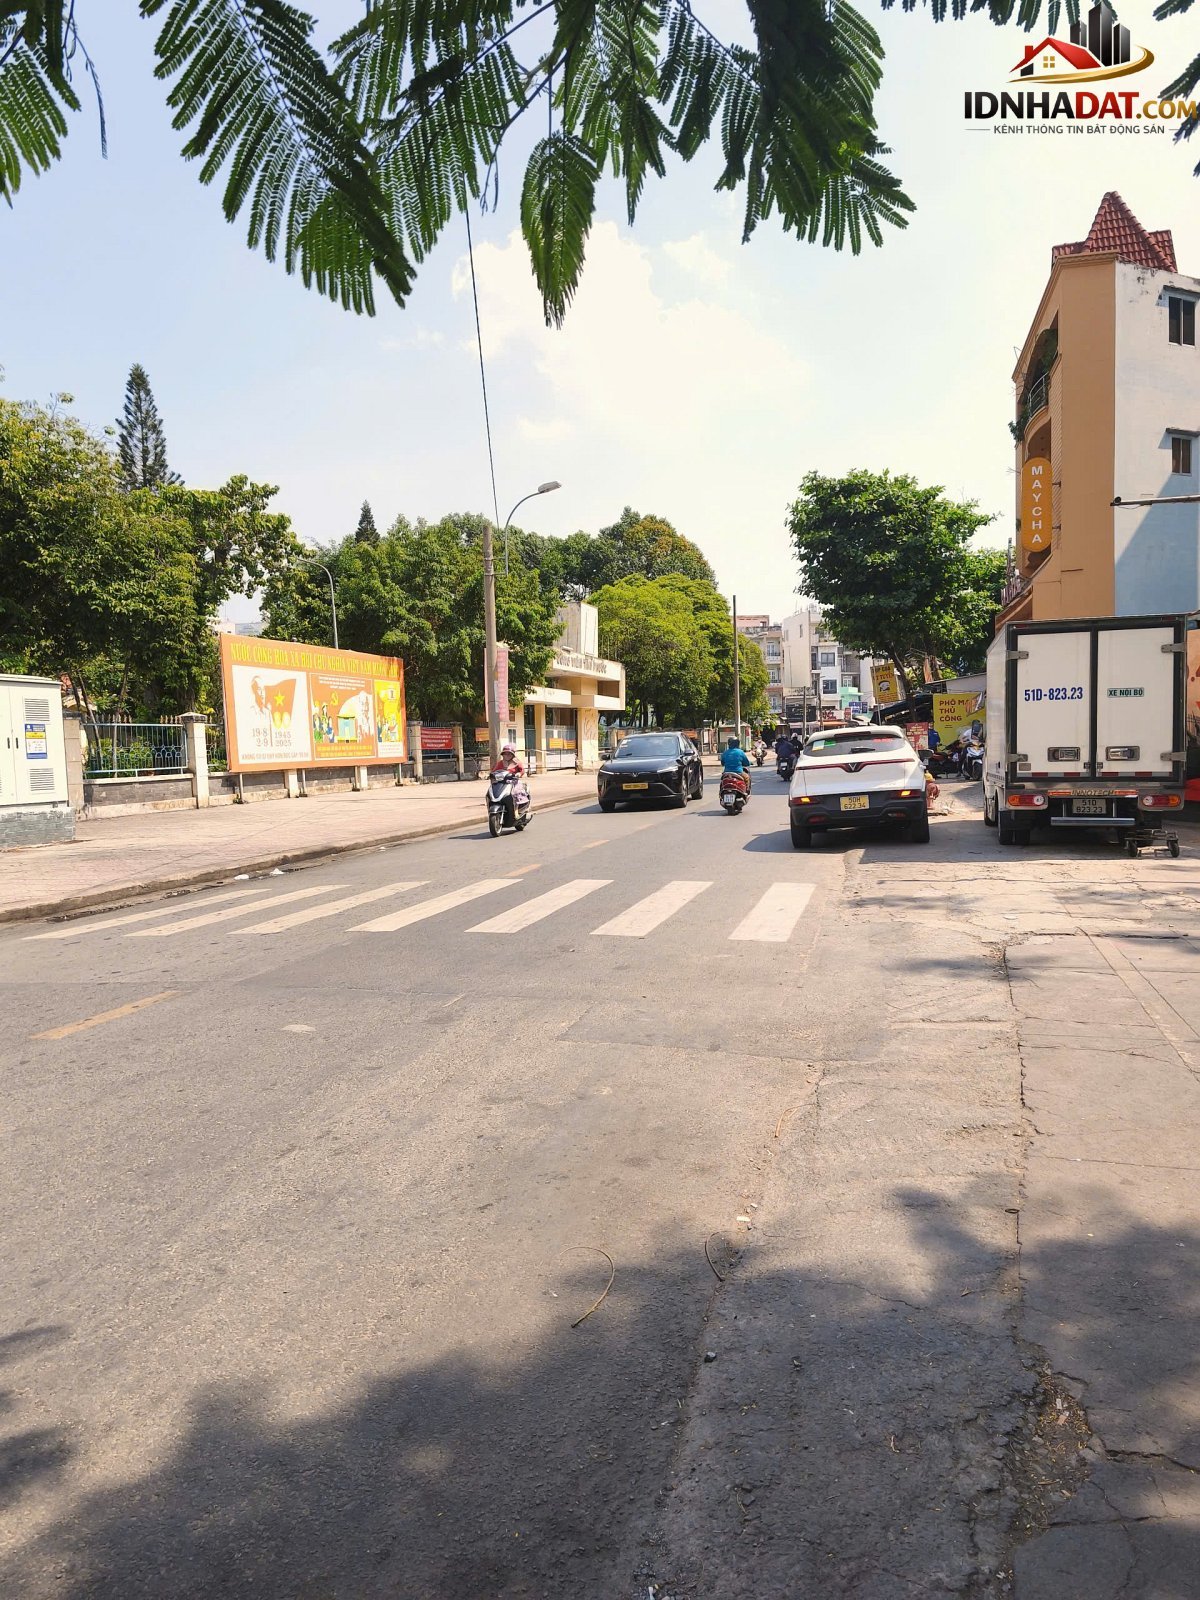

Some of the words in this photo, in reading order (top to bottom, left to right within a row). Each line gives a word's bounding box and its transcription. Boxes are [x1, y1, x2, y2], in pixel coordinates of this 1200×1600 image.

[1031, 465, 1043, 544] MAYCHA
[1024, 687, 1083, 702] 51D-823.23
[939, 705, 956, 714] THỦ
